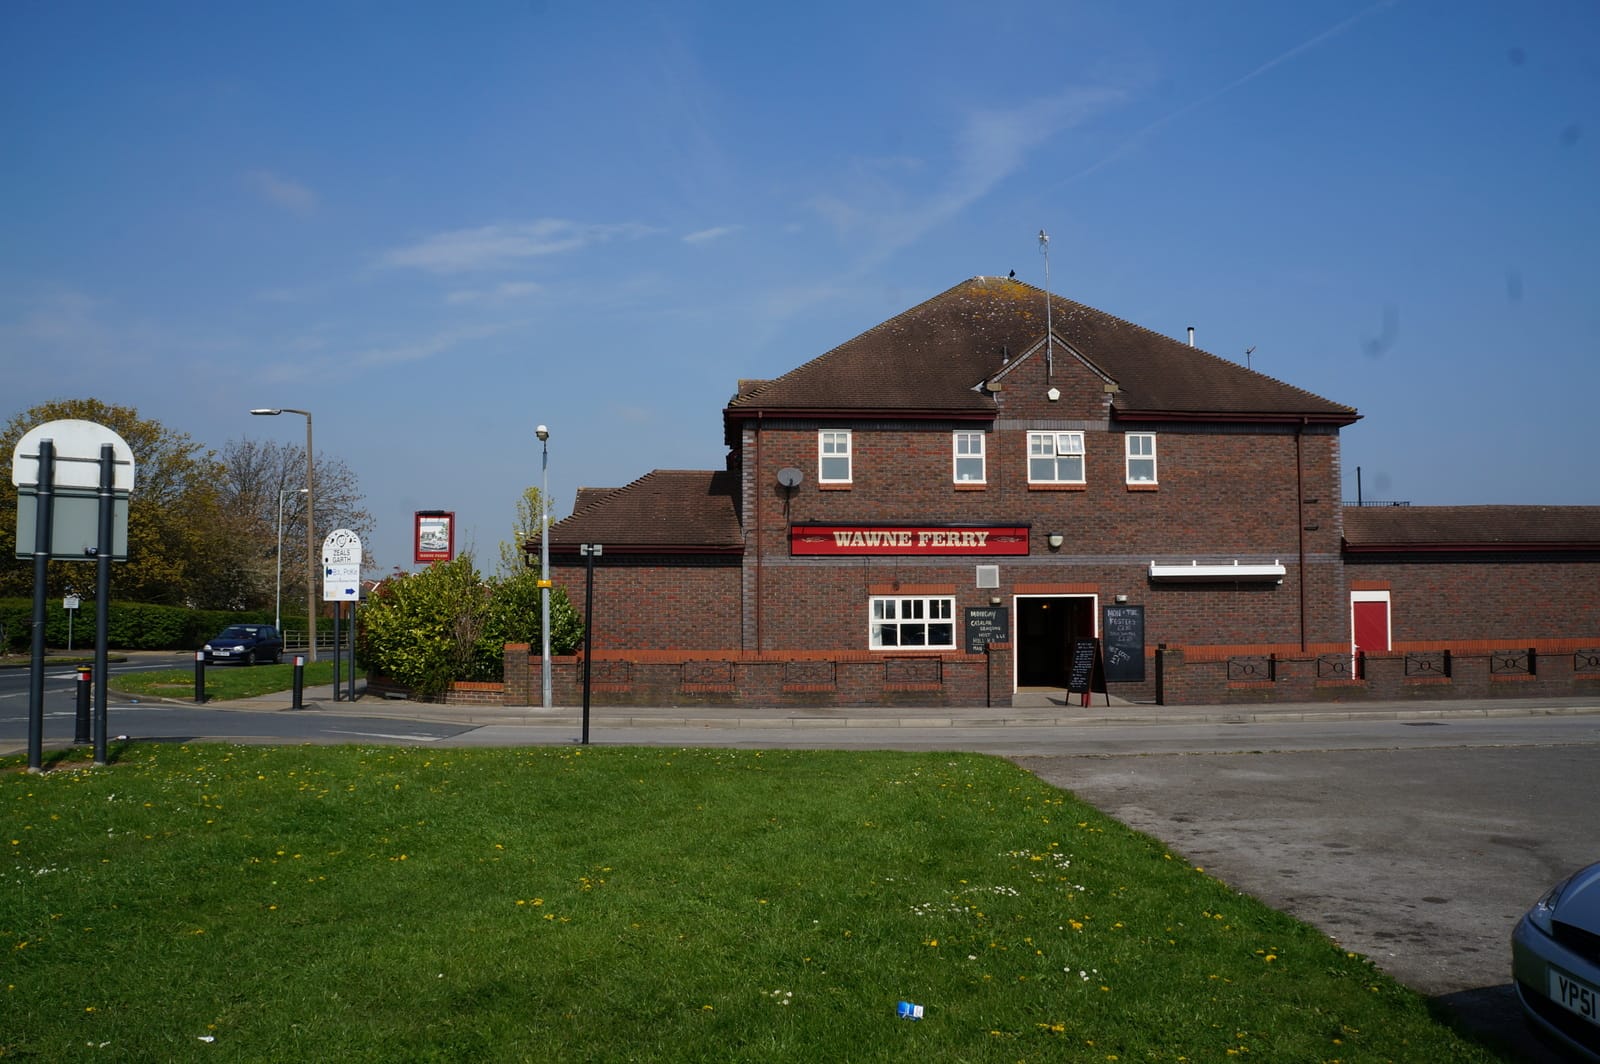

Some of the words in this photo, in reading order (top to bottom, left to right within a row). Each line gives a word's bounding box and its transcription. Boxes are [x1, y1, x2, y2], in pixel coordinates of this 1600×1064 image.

[833, 531, 912, 547] WAWNE
[917, 531, 989, 547] FERRY
[333, 549, 350, 557] ZEALS
